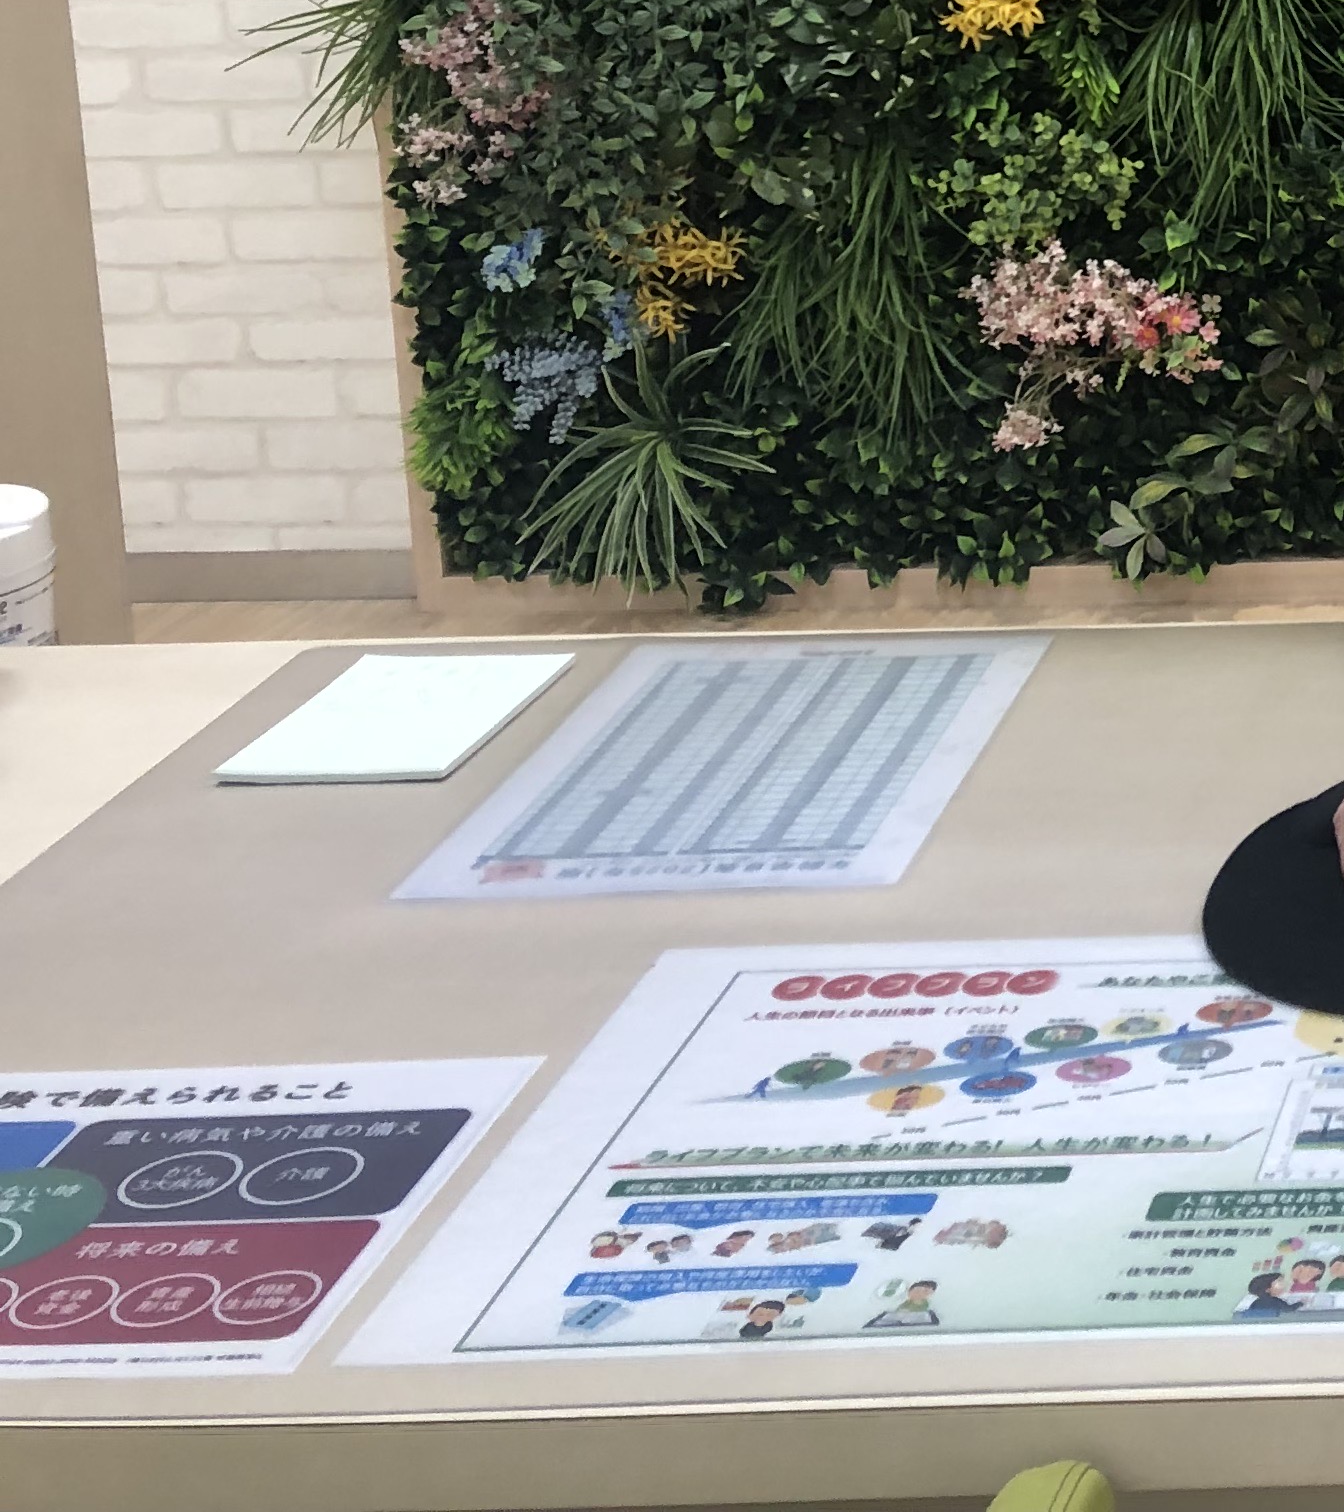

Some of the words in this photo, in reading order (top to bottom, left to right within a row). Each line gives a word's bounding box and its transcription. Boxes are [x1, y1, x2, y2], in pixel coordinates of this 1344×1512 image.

[76, 1237, 240, 1260] 将来の備え
